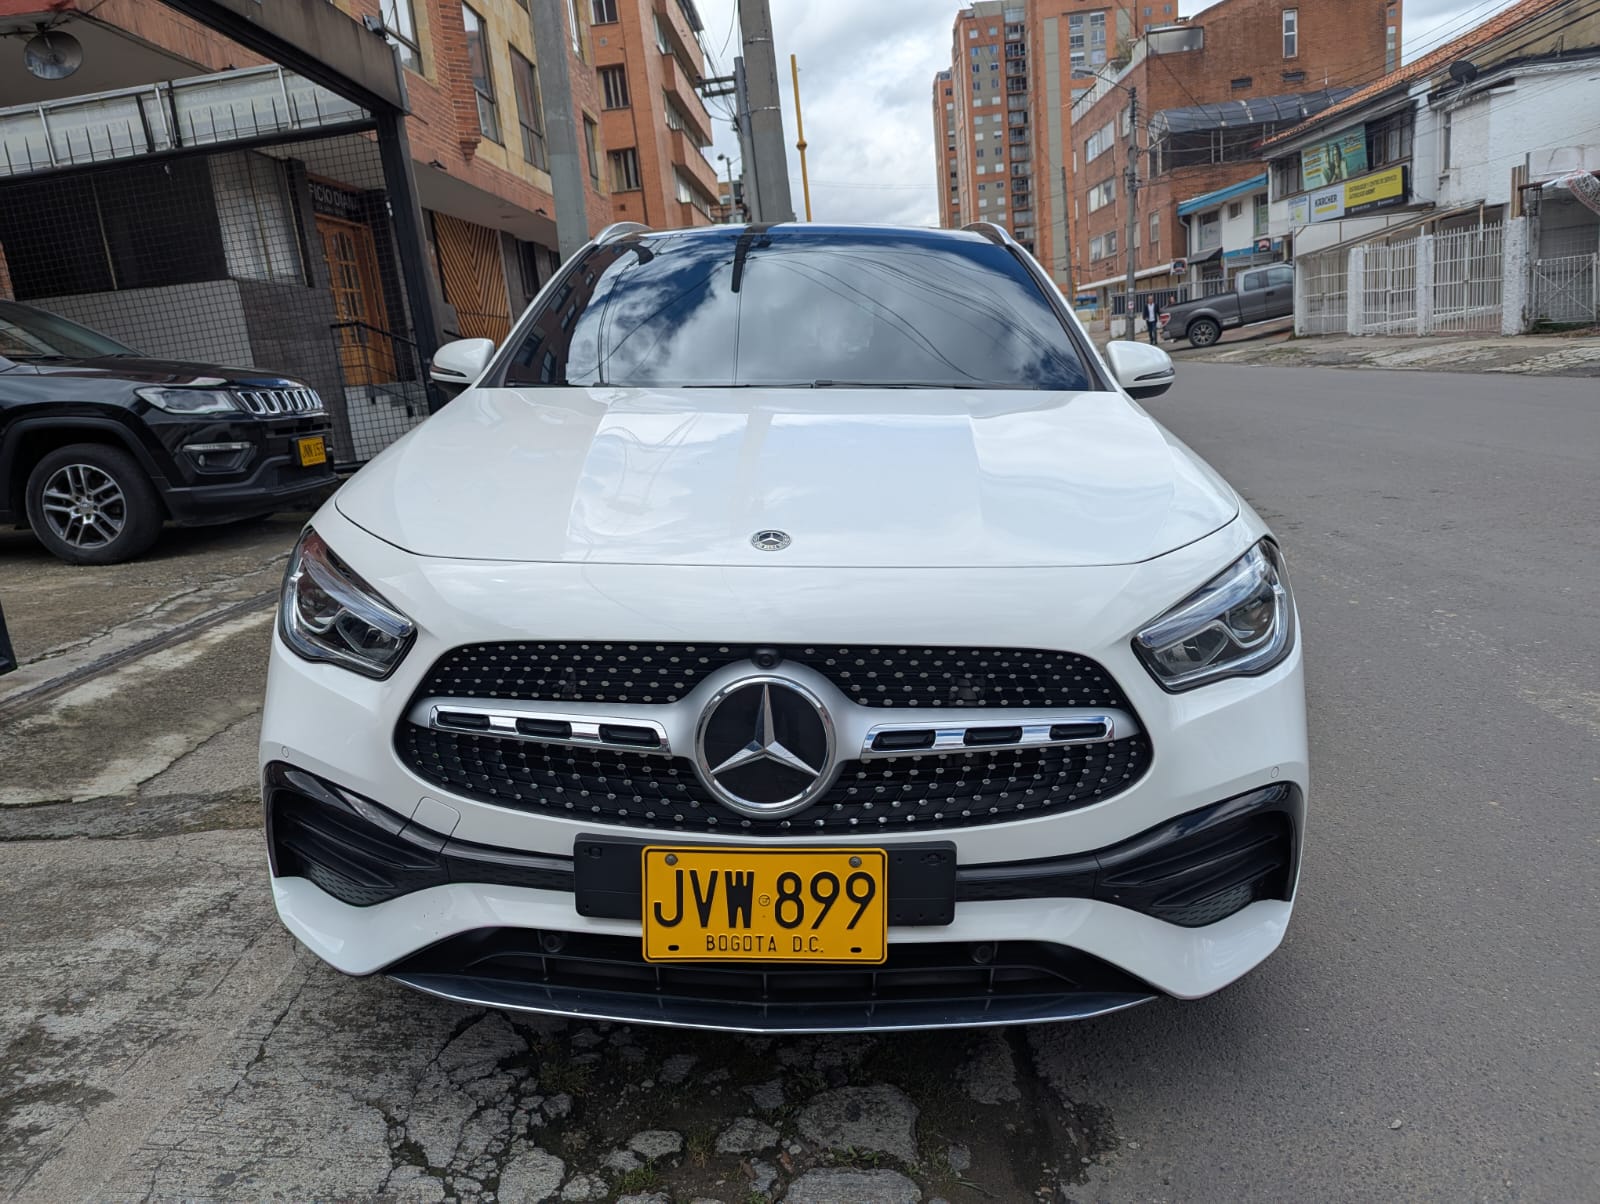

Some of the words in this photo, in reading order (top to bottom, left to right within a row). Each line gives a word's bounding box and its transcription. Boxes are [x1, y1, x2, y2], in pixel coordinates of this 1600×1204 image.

[653, 869, 755, 929] JVW
[774, 871, 876, 930] 899
[706, 935, 777, 952] BOGOTA
[792, 936, 824, 953] D.C.
